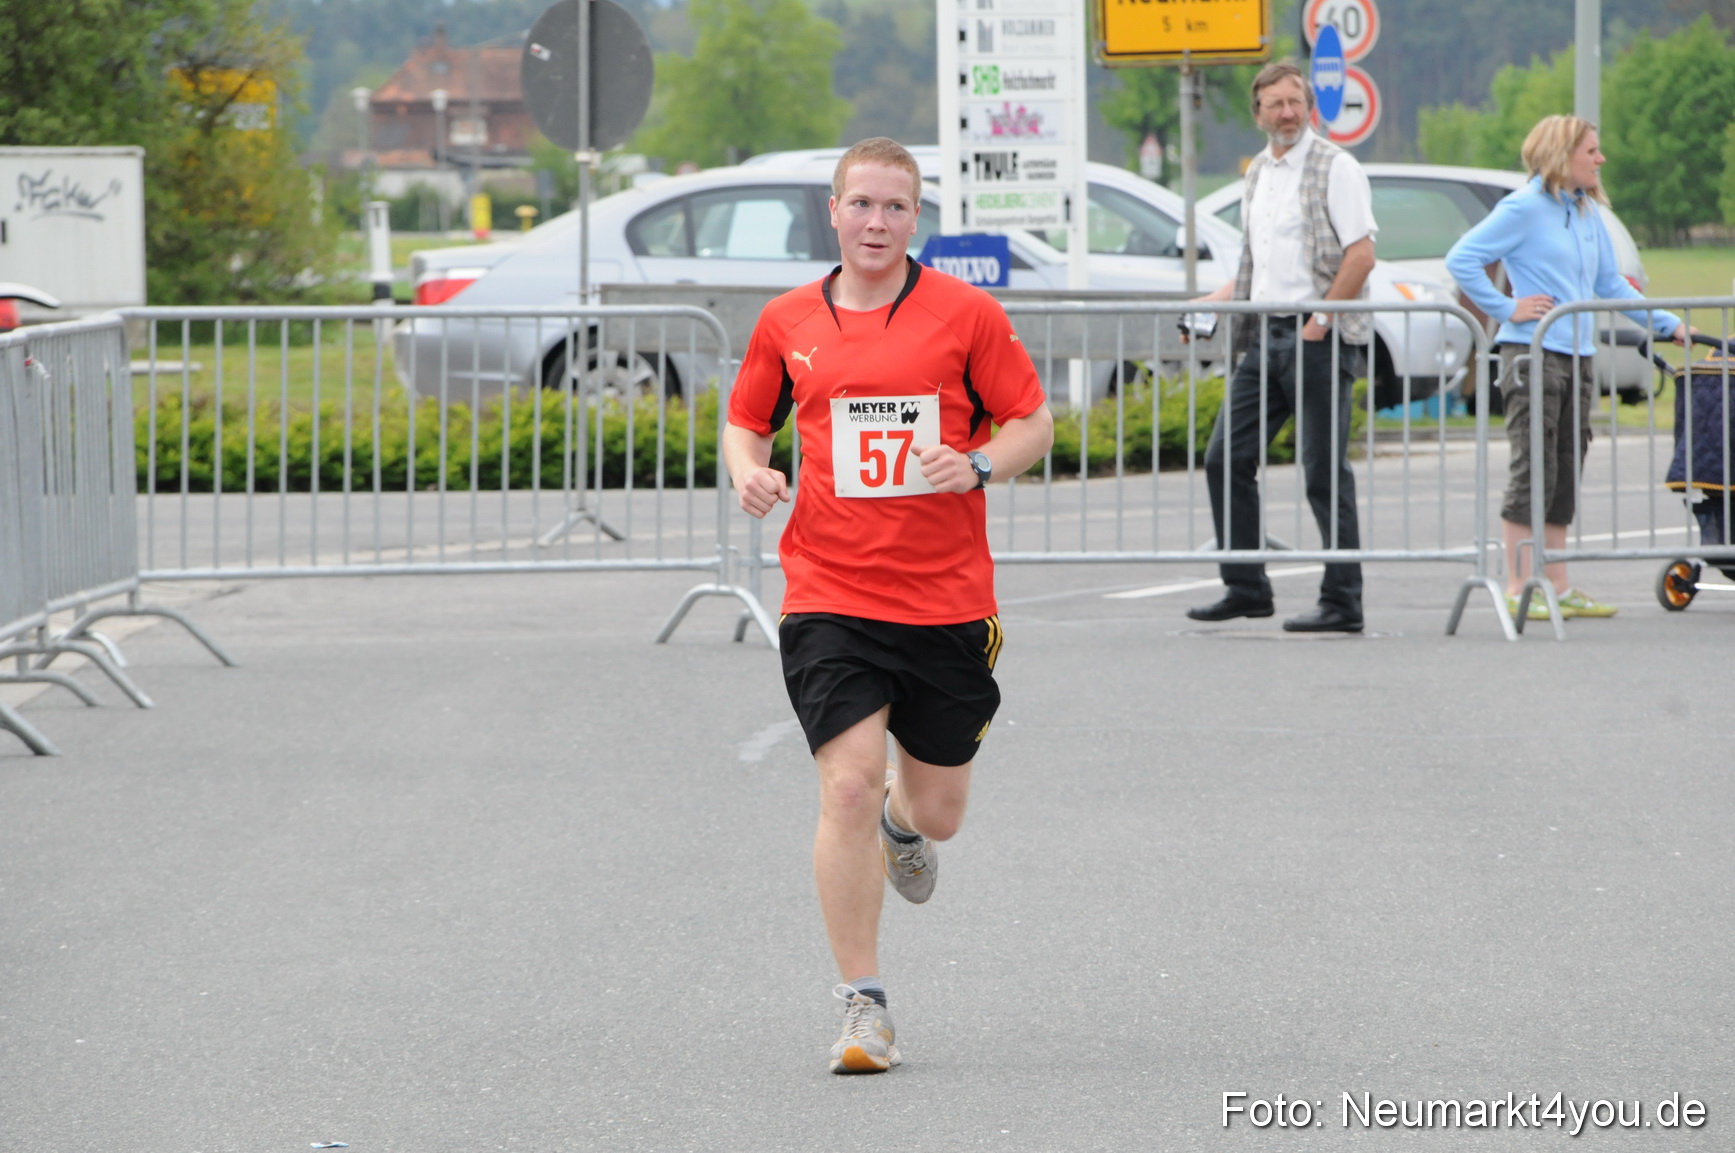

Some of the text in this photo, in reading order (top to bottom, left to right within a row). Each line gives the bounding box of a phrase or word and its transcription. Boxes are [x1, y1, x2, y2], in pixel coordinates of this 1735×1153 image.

[1162, 16, 1209, 33] 5 km
[974, 152, 1019, 181] THULE
[931, 256, 1000, 284] VOLVO
[849, 402, 897, 414] MEYER
[849, 414, 898, 423] WERBUNG
[860, 430, 914, 488] 57
